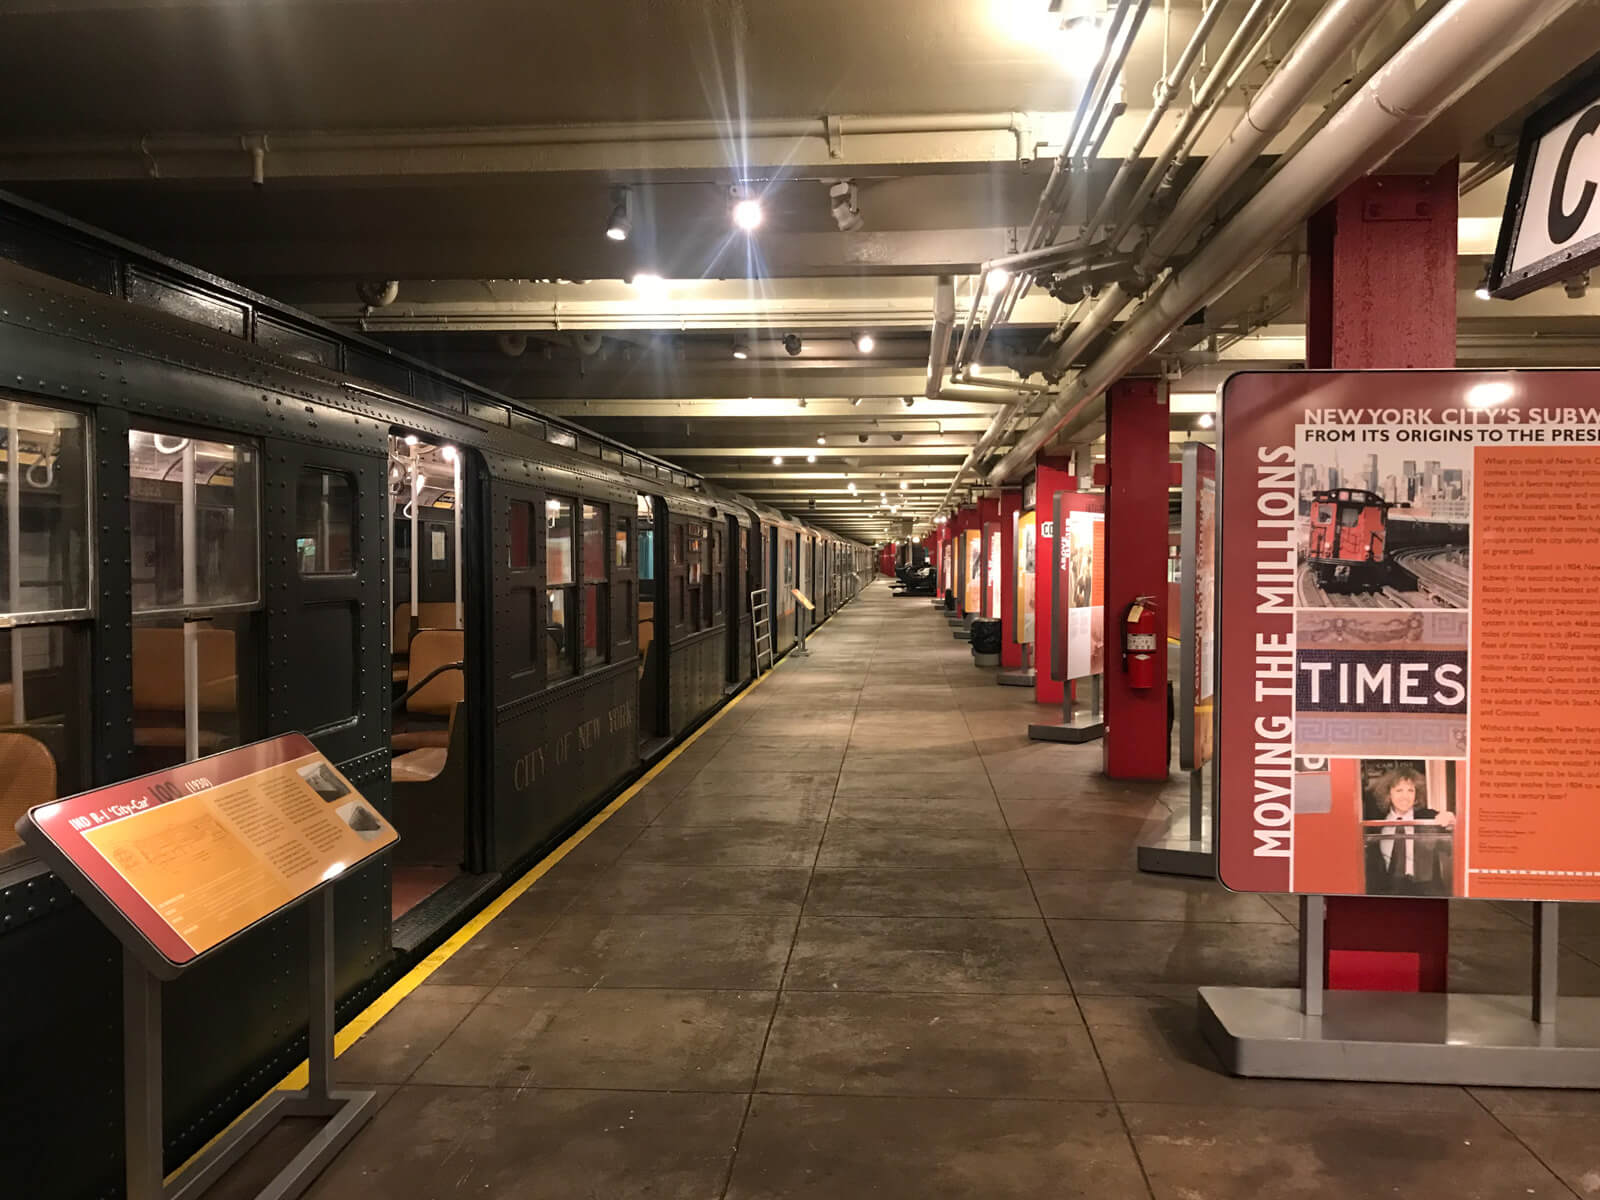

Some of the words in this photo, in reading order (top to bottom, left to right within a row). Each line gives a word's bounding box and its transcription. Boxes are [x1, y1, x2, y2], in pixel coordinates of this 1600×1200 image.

[1304, 408, 1364, 424] NEW
[1367, 408, 1434, 424] YORK
[1441, 408, 1521, 425] CITY’S
[1305, 429, 1356, 442] FROM
[1362, 429, 1390, 442] ITS
[1396, 429, 1473, 442] ORIGINS
[1477, 429, 1503, 442] TO
[1507, 429, 1545, 442] THE
[1551, 429, 1600, 442] PRES
[1256, 445, 1296, 614] MILLIONS
[1255, 633, 1295, 702] THE
[1300, 662, 1465, 706] TIMES
[514, 743, 549, 793] CITY
[555, 731, 574, 766] OF
[577, 717, 601, 752] NEW
[608, 700, 632, 734] YORK
[1253, 716, 1293, 857] MOVING
